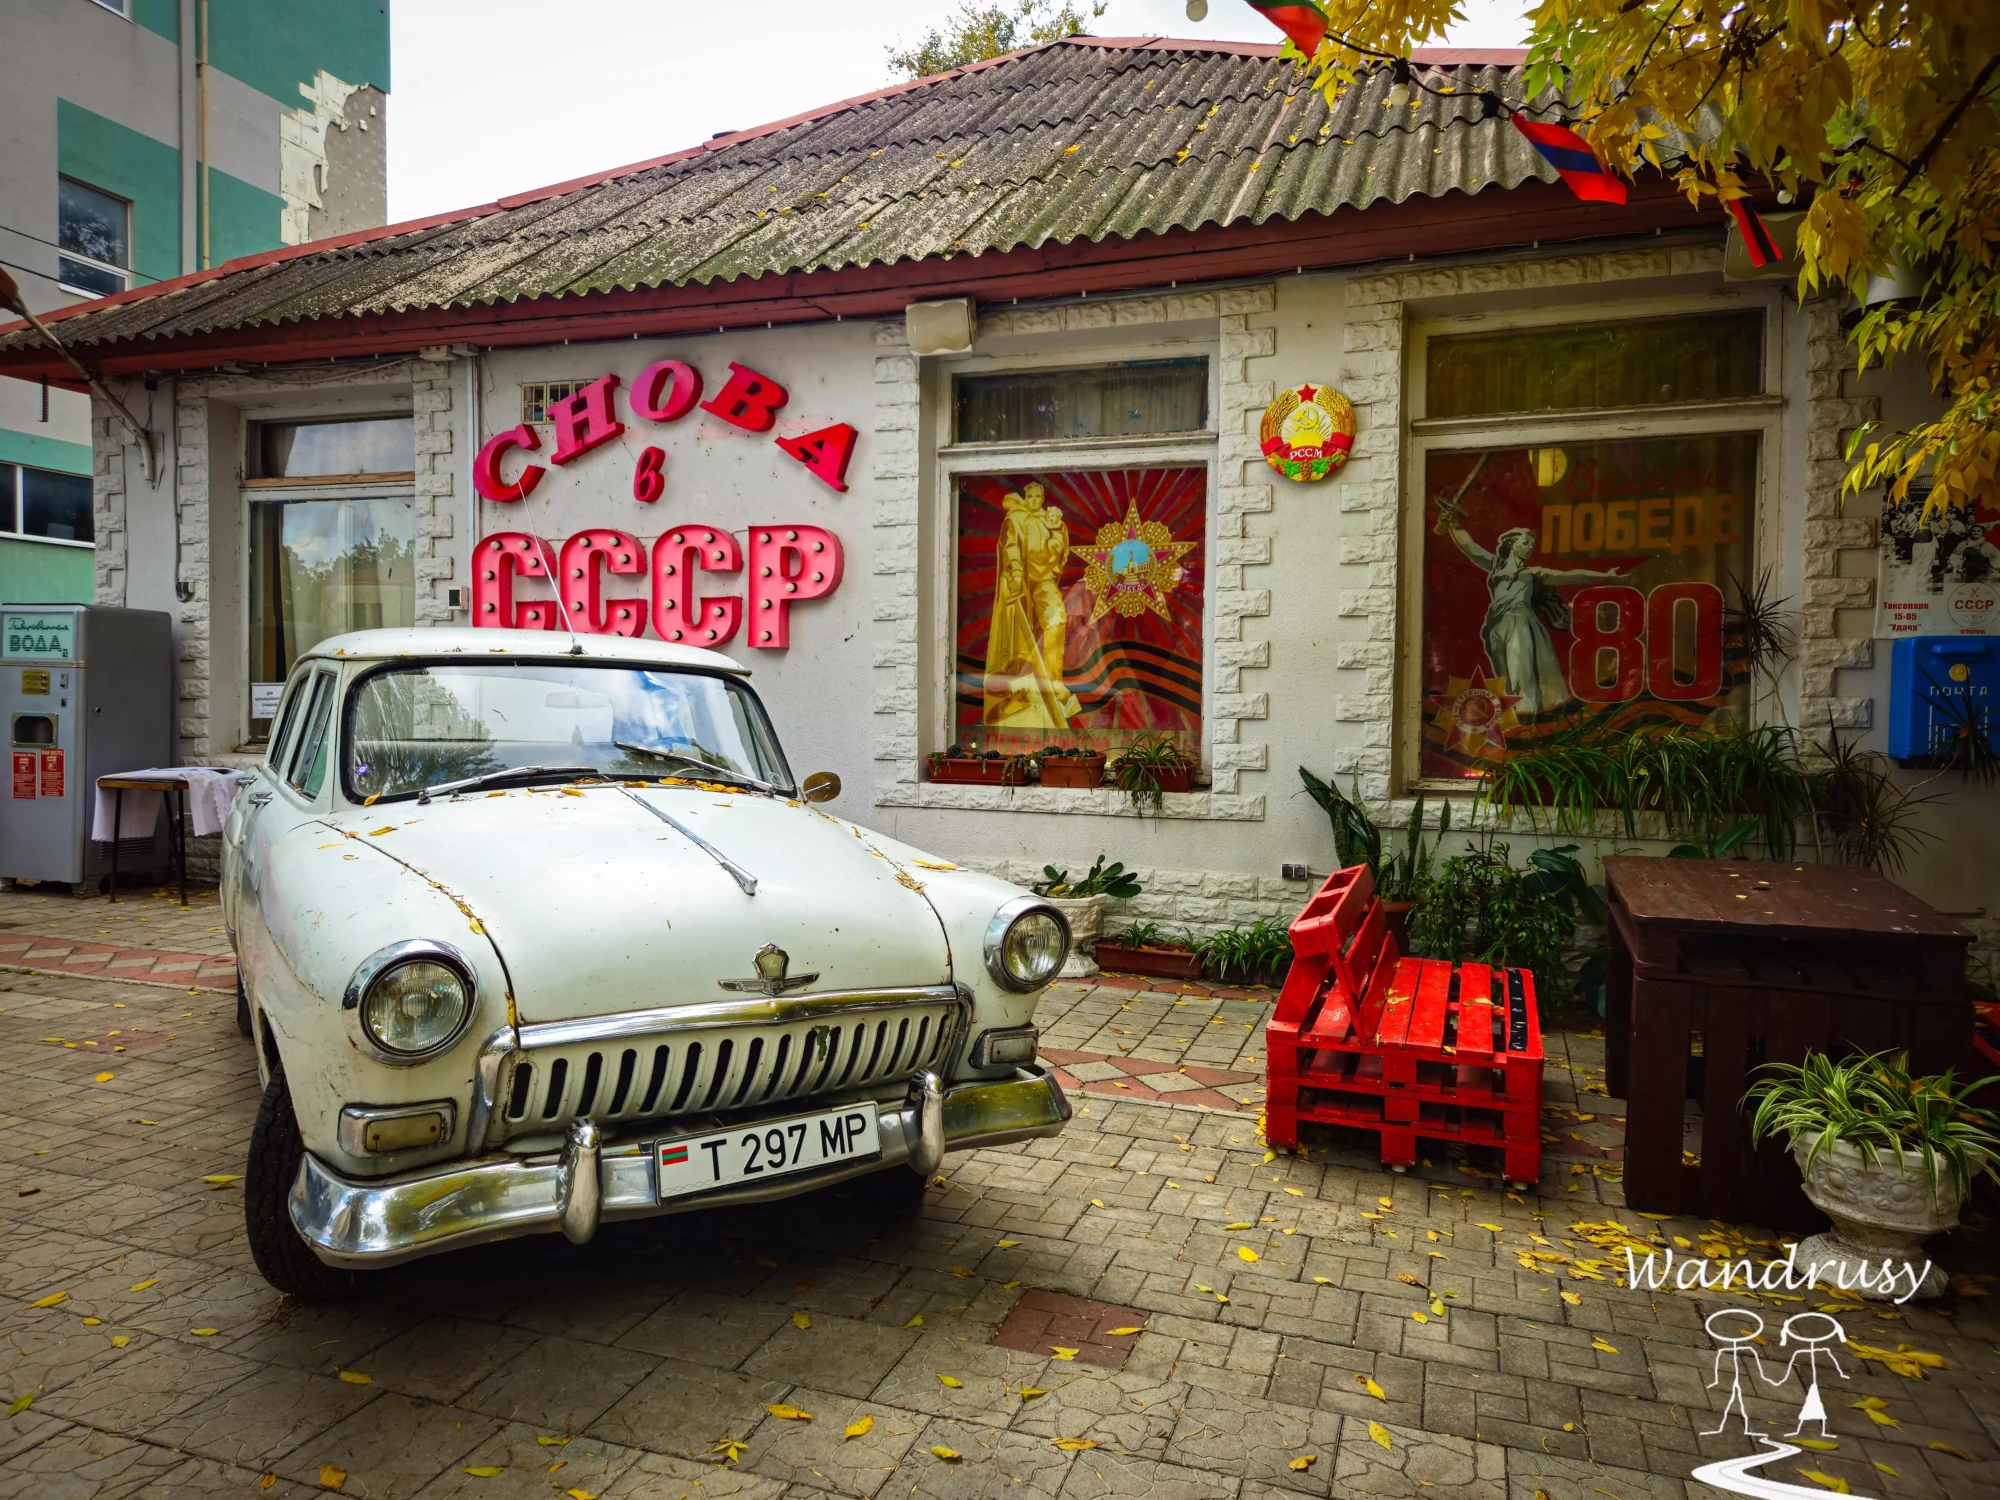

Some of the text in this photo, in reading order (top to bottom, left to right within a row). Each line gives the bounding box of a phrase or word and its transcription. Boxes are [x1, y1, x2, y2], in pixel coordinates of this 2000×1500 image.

[473, 359, 859, 502] СНОВА
[1290, 448, 1323, 460] РССМ
[1540, 494, 1742, 555] ПОБЕДЕ
[472, 524, 844, 649] СССР
[1954, 600, 1994, 610] СССР
[1883, 602, 1929, 611] Таксопарк
[10, 635, 62, 651] ВОДА
[1570, 582, 1724, 703] 80
[1930, 685, 1988, 697] ПОЧТА
[700, 1113, 867, 1181] T 297 MP
